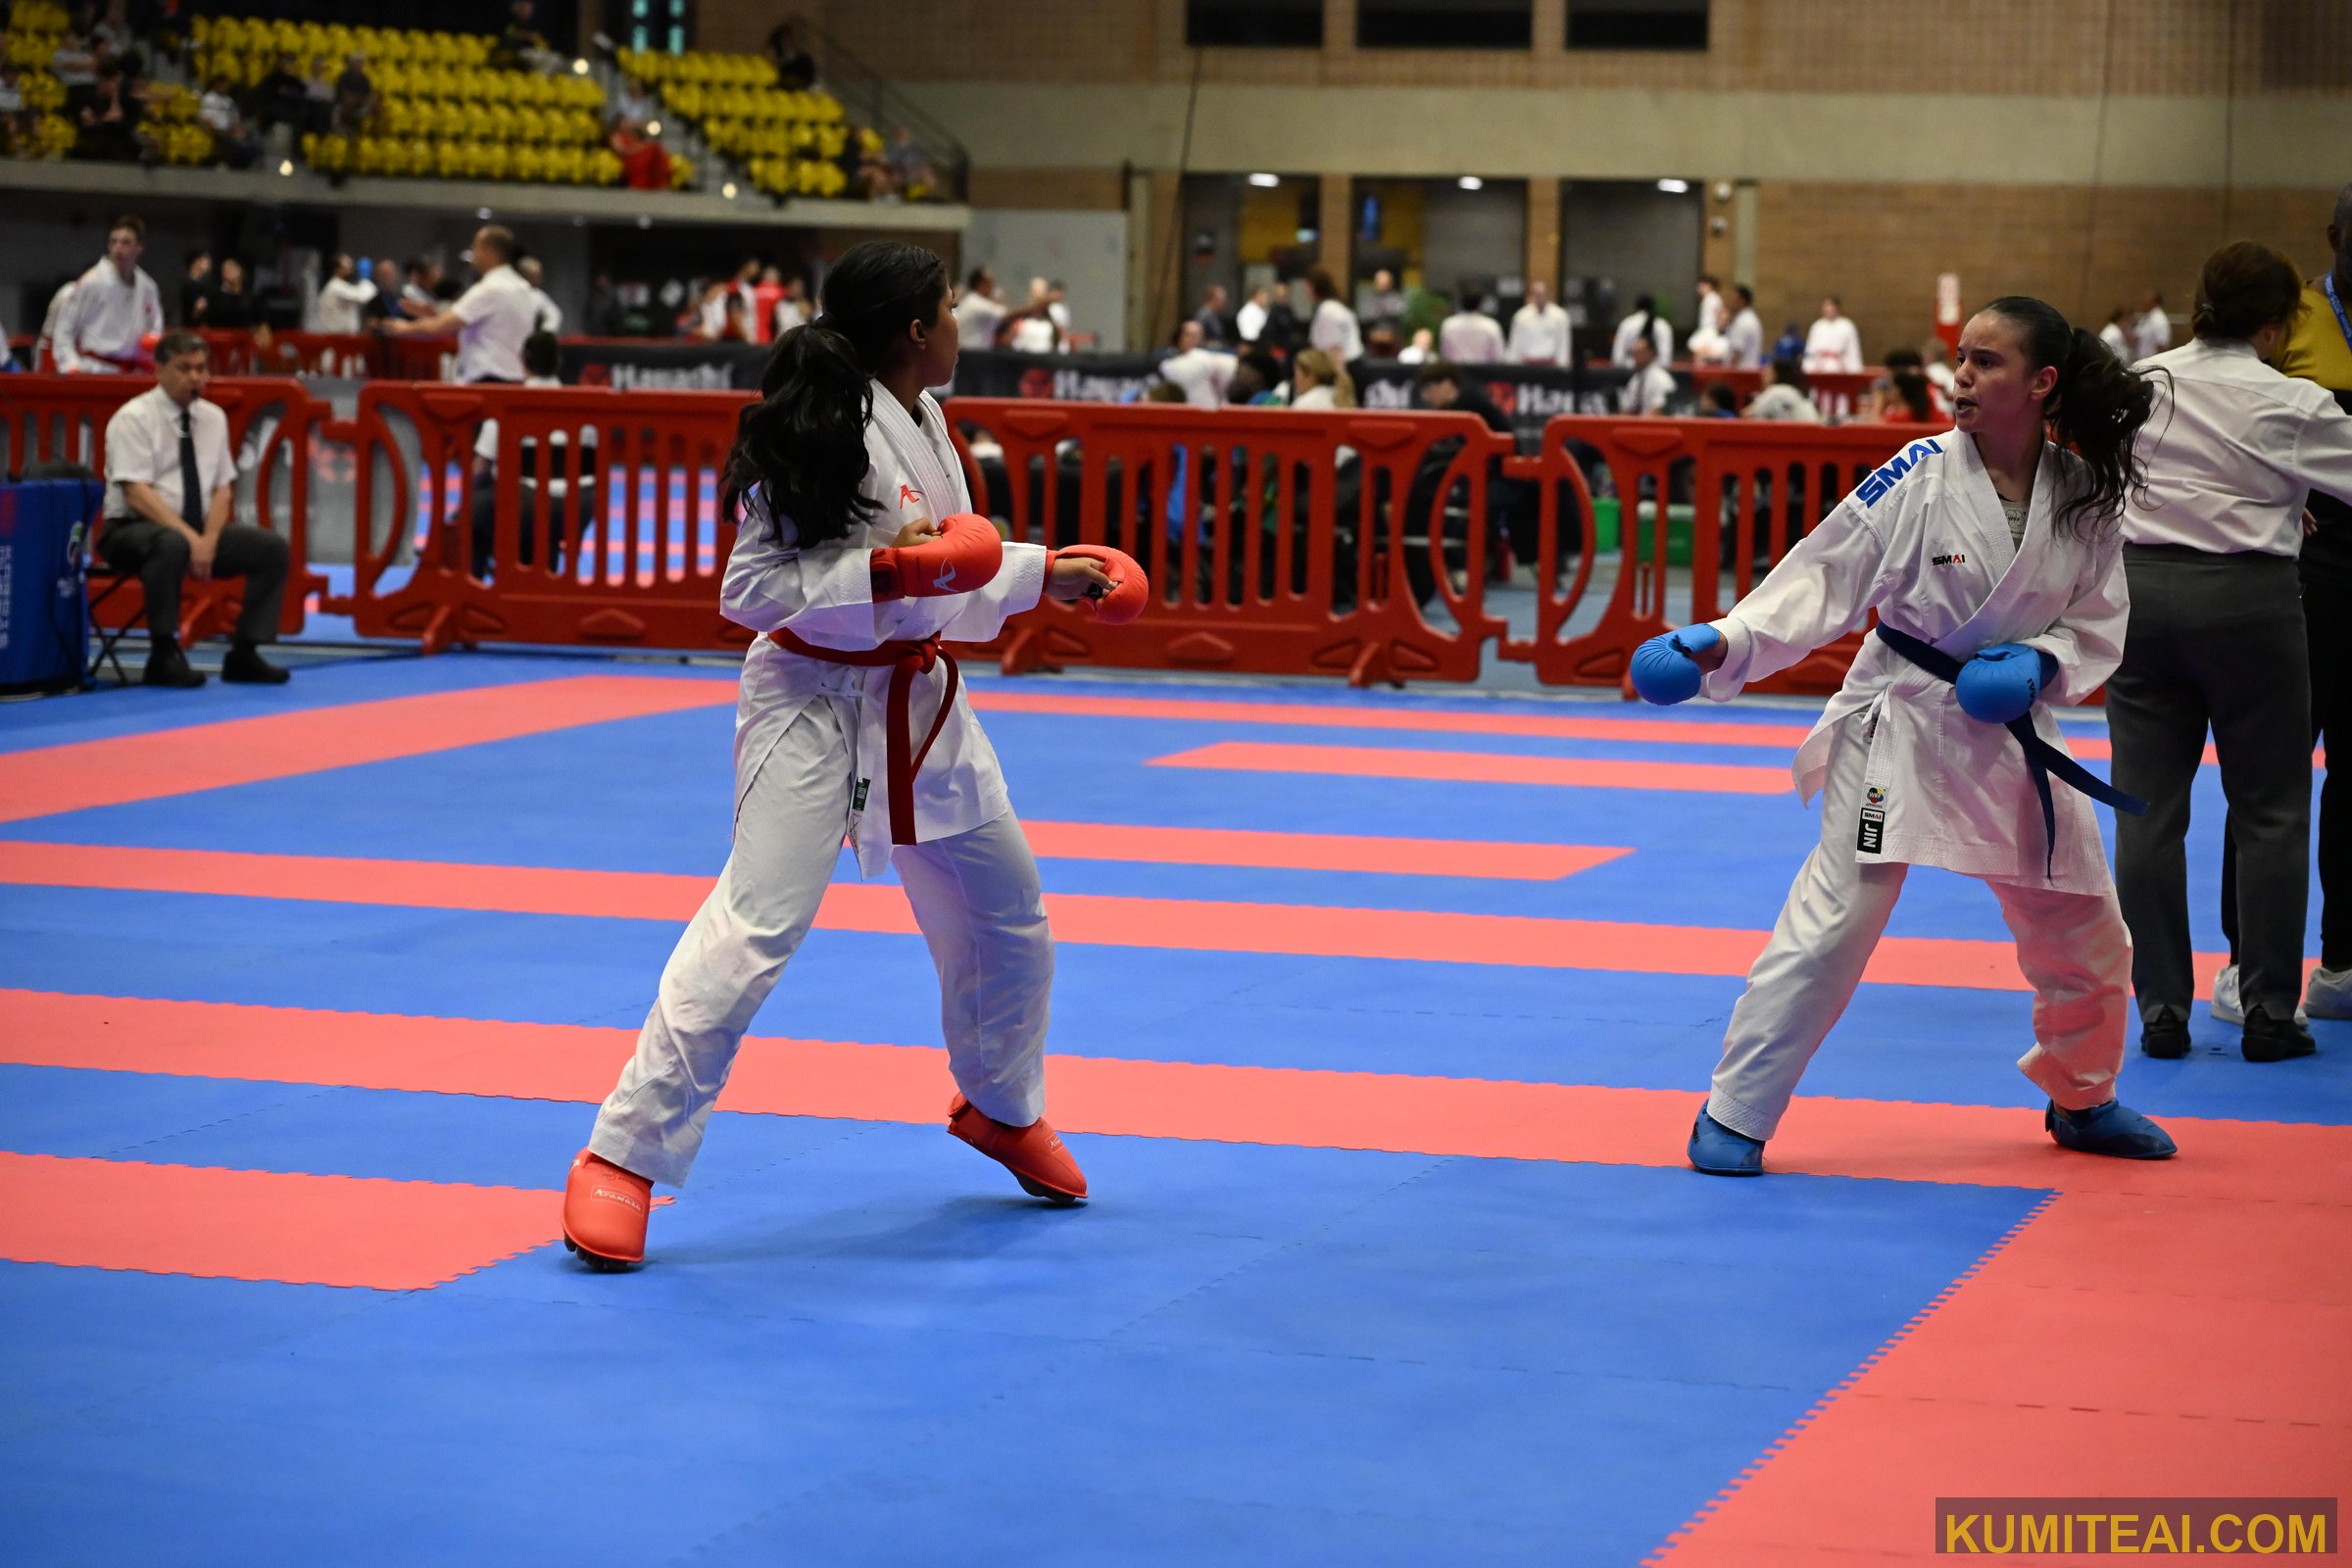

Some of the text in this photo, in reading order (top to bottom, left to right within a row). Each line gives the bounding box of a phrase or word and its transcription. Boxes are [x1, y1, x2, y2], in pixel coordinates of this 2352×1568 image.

[1855, 439, 1943, 509] SMAI
[1932, 554, 1966, 566] SMAI
[1864, 811, 1882, 820] SMAI
[1862, 823, 1879, 849] JIN
